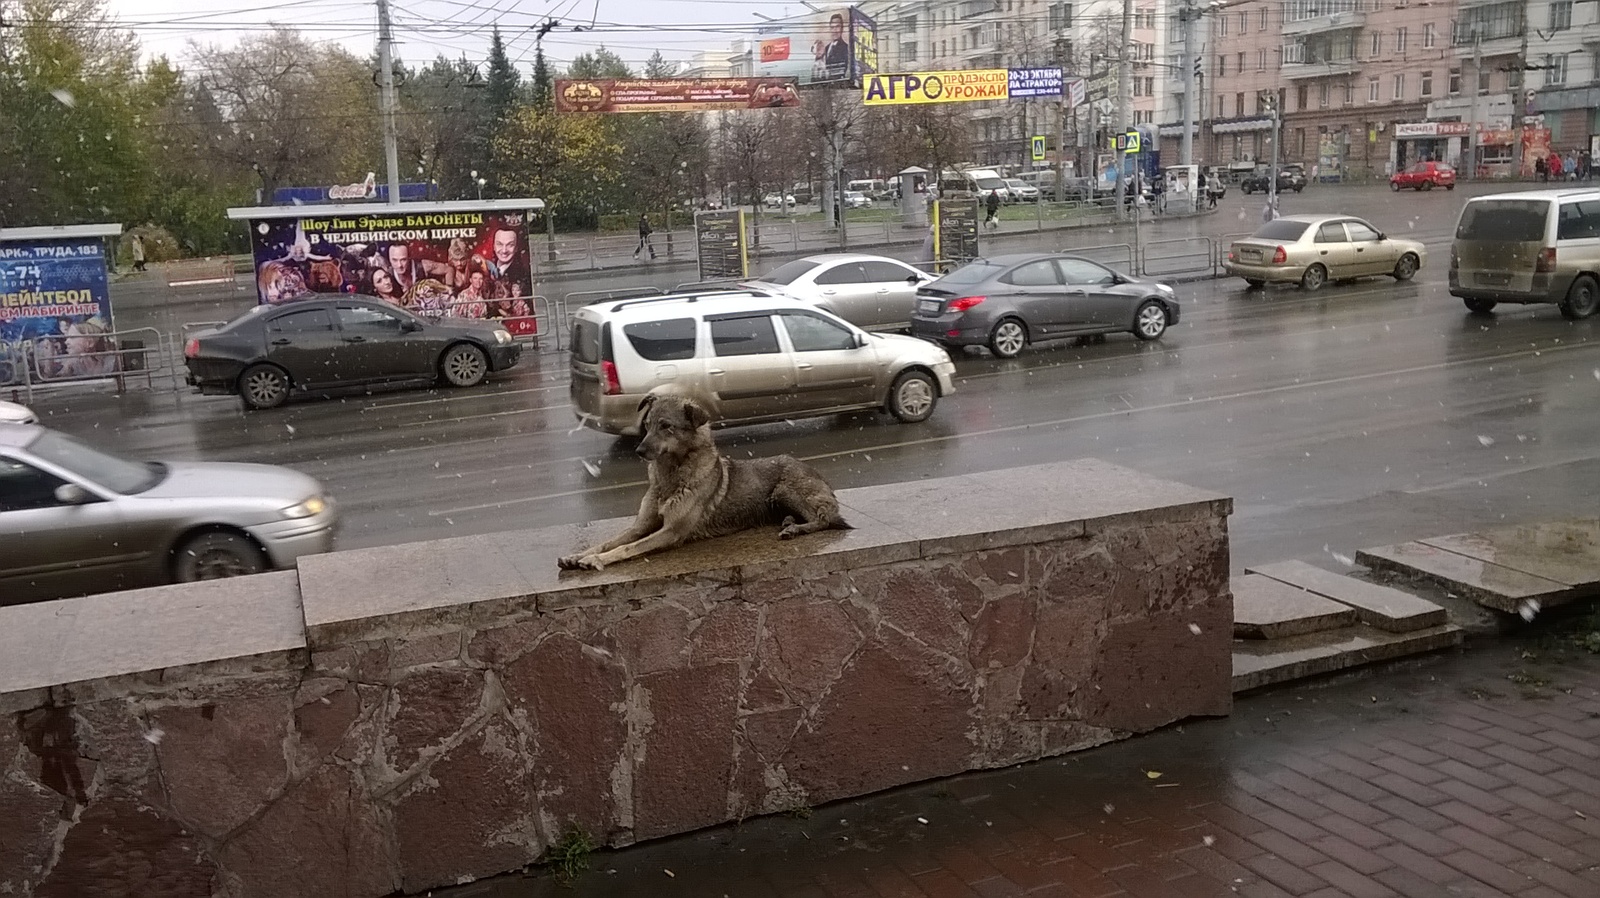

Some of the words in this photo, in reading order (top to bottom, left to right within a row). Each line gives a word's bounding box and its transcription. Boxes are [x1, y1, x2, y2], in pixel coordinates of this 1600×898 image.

[944, 73, 1006, 84] ПРОДЭКСПО
[1009, 71, 1029, 80] 20-23
[866, 76, 942, 100] АГРО
[1021, 79, 1062, 88] «ТРАКТОР»
[301, 220, 330, 232] Шоу
[406, 214, 484, 227] БАРОНЕТЫ
[310, 233, 320, 244] В
[322, 229, 429, 244] ЧЕЛЯБИНСКОМ
[431, 228, 477, 240] ЦИРКЕ
[22, 303, 99, 317] ЛАБИРИНТЕ
[520, 322, 531, 330] 0+
